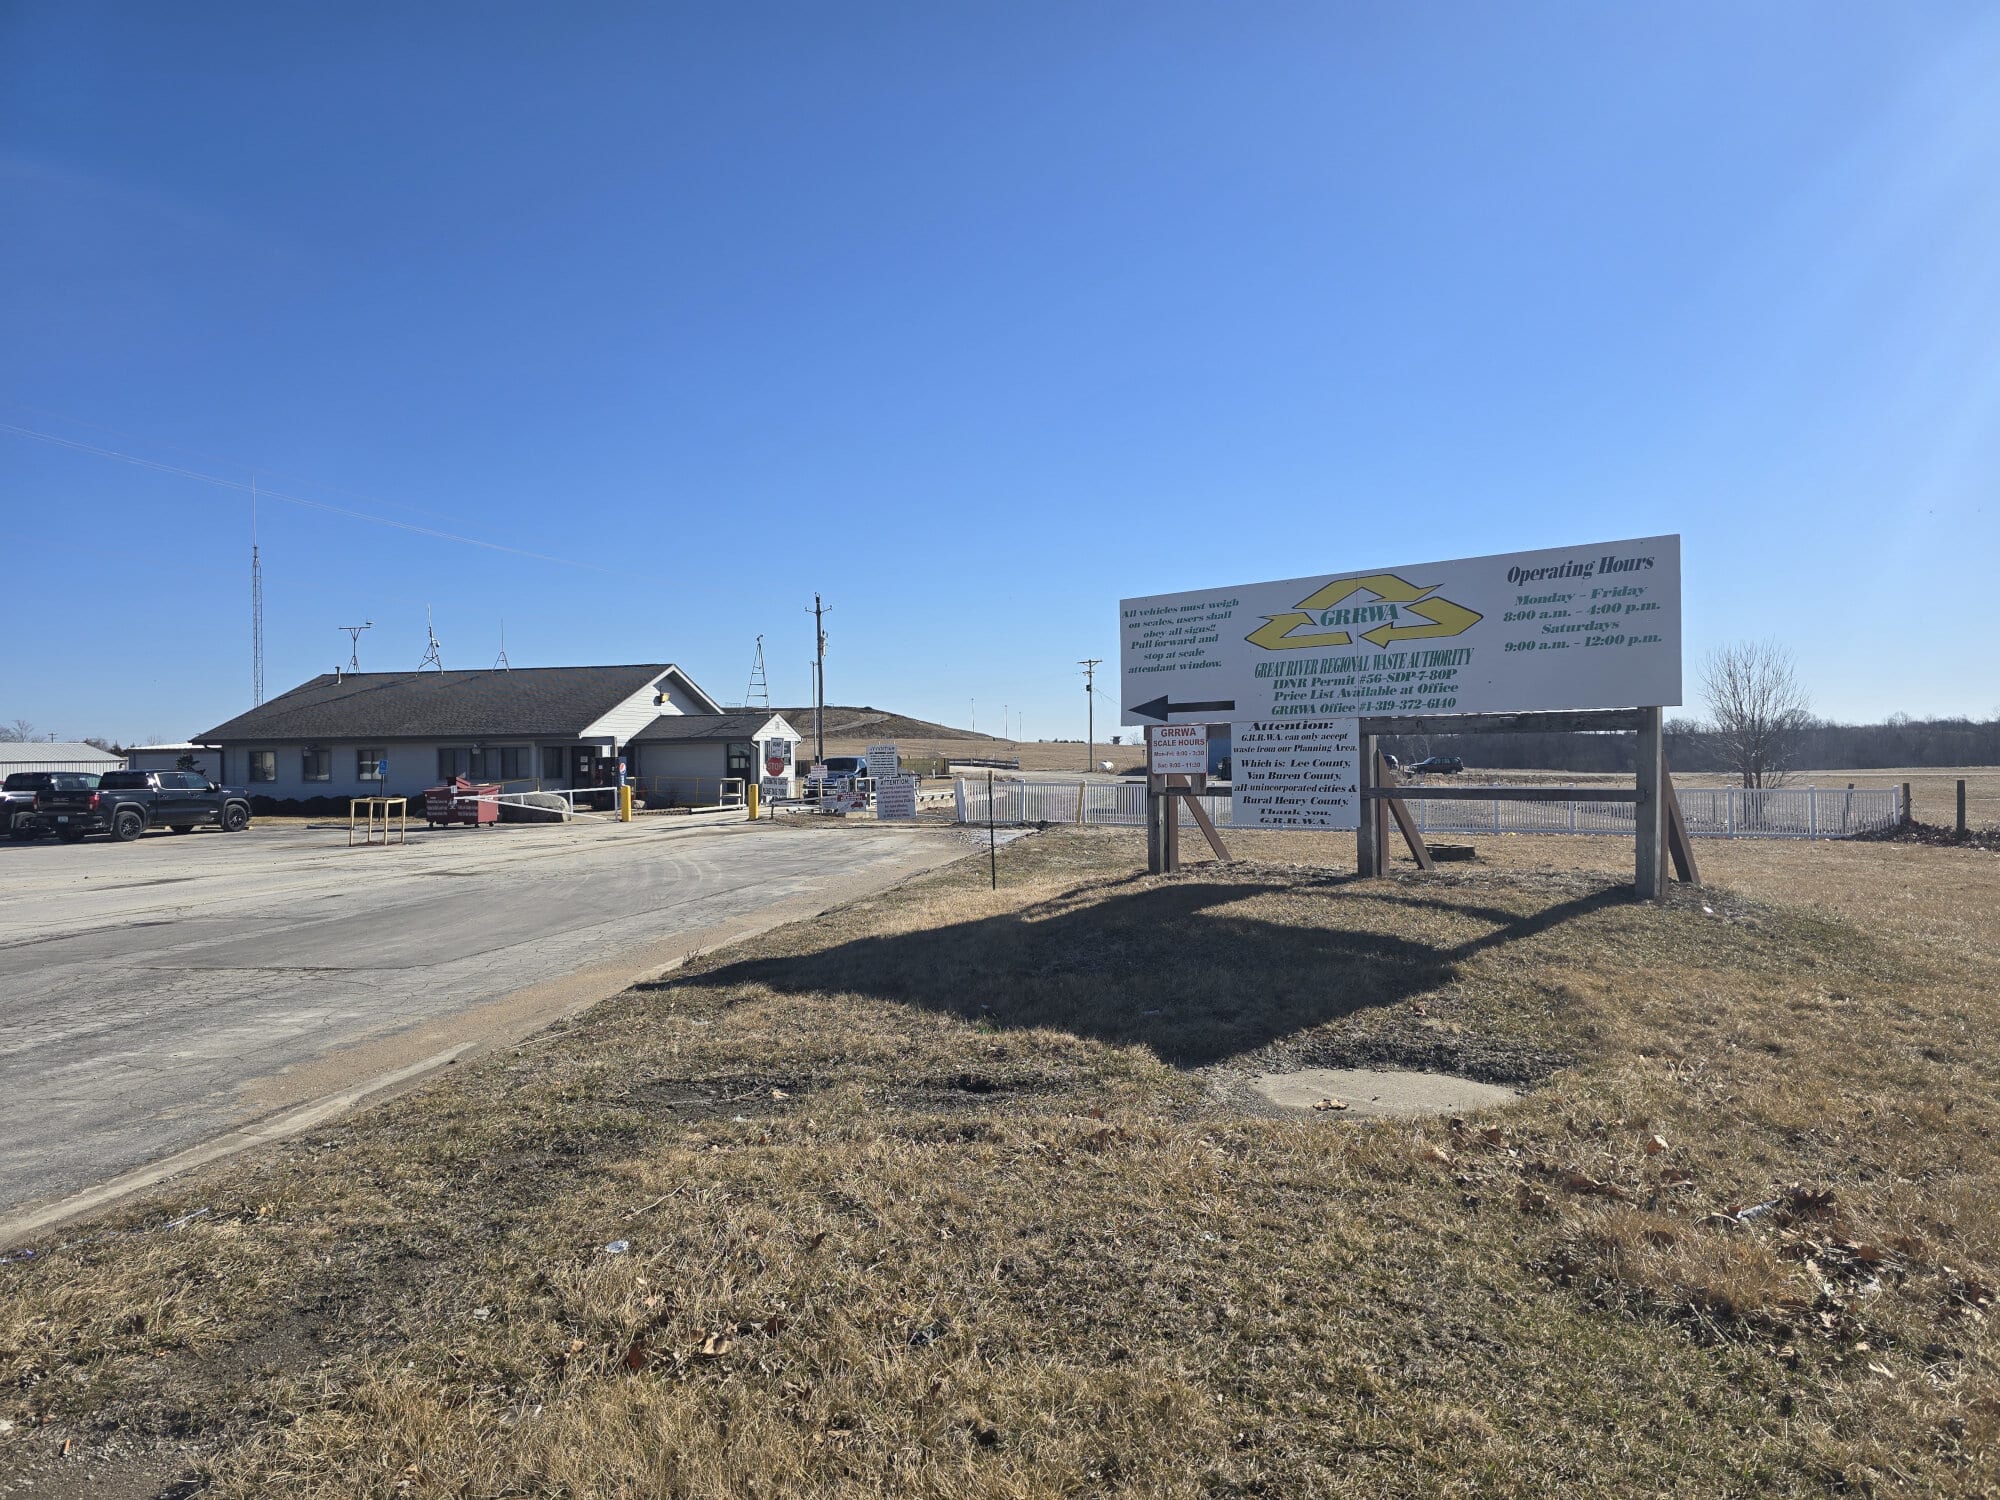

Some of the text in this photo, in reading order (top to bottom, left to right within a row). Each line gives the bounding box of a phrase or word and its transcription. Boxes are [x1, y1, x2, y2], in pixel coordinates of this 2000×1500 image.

[1507, 555, 1654, 586] Operating Hours
[1514, 592, 1576, 606] Monday
[1589, 585, 1648, 600] Friday
[1122, 598, 1239, 618] All vehicles must weigh
[1320, 604, 1400, 627] GRRWA
[1503, 610, 1536, 622] 8:00
[1538, 609, 1571, 619] a.m.
[1586, 603, 1621, 616] 4:00
[1623, 602, 1661, 614] p.m.
[1142, 618, 1174, 627] scales,
[1176, 616, 1204, 624] users
[1206, 611, 1232, 620] shall
[1143, 624, 1216, 639] obey all signs!!
[1541, 620, 1620, 635] Saturdays
[1131, 634, 1219, 650] Pull forward and
[1504, 640, 1536, 652] 9:00
[1538, 640, 1570, 650] a.m.
[1584, 634, 1625, 647] 12:00
[1627, 633, 1662, 646] p.m.
[1143, 648, 1205, 661] stop at scale
[1128, 659, 1222, 674] attendant window.
[1255, 647, 1475, 678] GREAT RIVER REGIONAL WASTE AUTHORITY
[1273, 668, 1458, 690] IDNR Permit #56-SDP-7-80P
[1273, 682, 1459, 701] Price List Available at Office
[1271, 698, 1457, 716] GRRWA Office #1-319-372-6140
[1160, 728, 1196, 737] GRRWA
[1249, 721, 1334, 732] Attention:
[1178, 738, 1205, 746] HOURS
[1241, 734, 1283, 742] G.R.R.W.A.
[1301, 732, 1318, 741] only
[1320, 732, 1348, 741] accept
[1256, 745, 1276, 753] from
[1294, 744, 1331, 753] Planning
[1333, 744, 1357, 752] Area.
[768, 762, 783, 770] STOP
[1241, 759, 1272, 767] Which
[1290, 759, 1310, 767] Lee
[1247, 771, 1265, 780] Van
[1267, 771, 1300, 780] Buren
[1318, 784, 1346, 793] cities
[1348, 784, 1358, 793] &
[1242, 796, 1272, 804] Rural
[1275, 796, 1308, 806] Henry
[1258, 808, 1301, 816] Thank
[1259, 817, 1330, 825] G.R.R.W.A.
